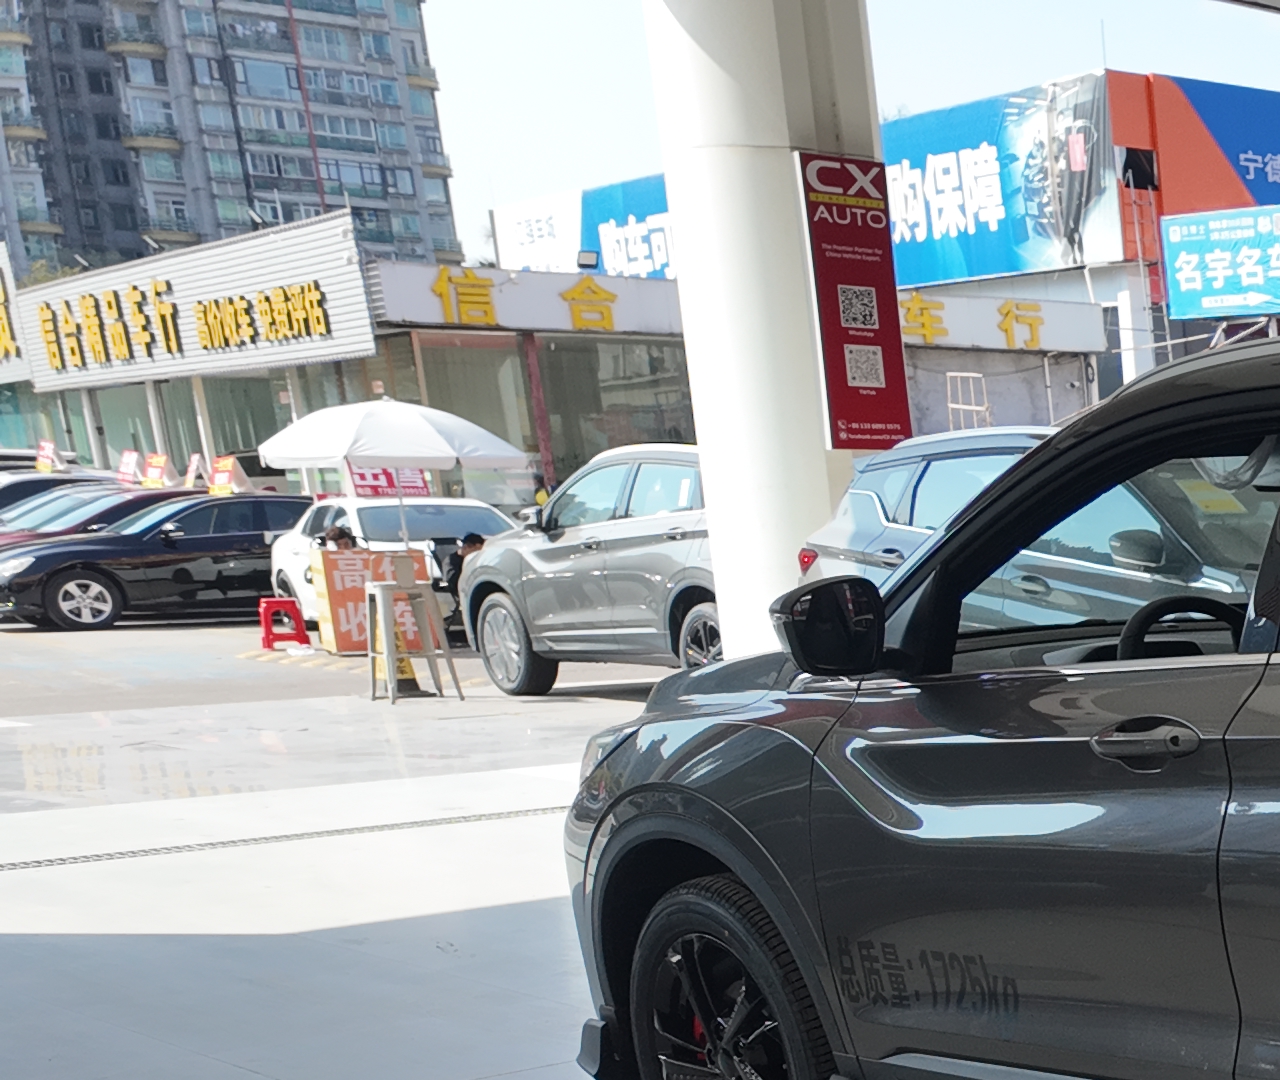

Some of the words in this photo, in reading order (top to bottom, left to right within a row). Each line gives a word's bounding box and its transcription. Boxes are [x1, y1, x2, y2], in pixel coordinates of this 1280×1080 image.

[806, 160, 883, 199] CX
[813, 204, 887, 229] AUTO
[37, 278, 178, 370] 信合精品车行
[256, 280, 327, 341] 免费评估
[431, 264, 618, 331] 信合
[900, 292, 1044, 349] 车行
